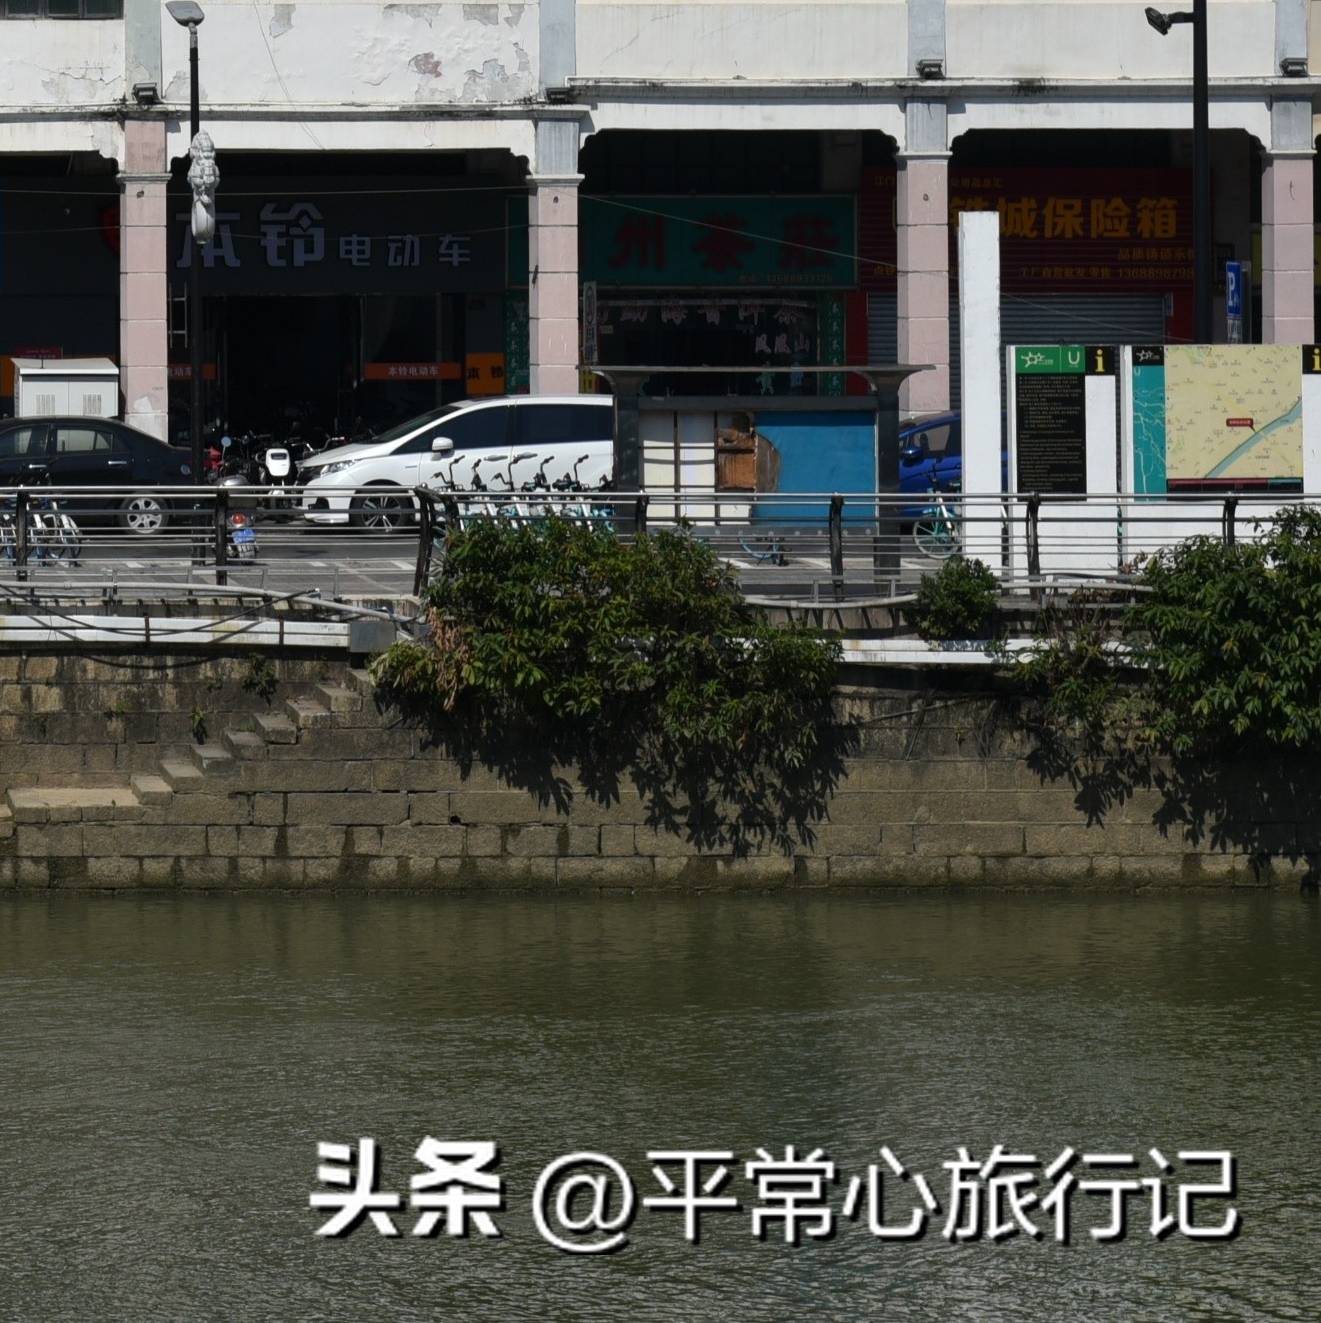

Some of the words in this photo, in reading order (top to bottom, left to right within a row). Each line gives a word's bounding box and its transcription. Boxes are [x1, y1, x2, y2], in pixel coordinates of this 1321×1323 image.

[1227, 271, 1236, 307] P
[387, 365, 440, 377] 本铃电动车
